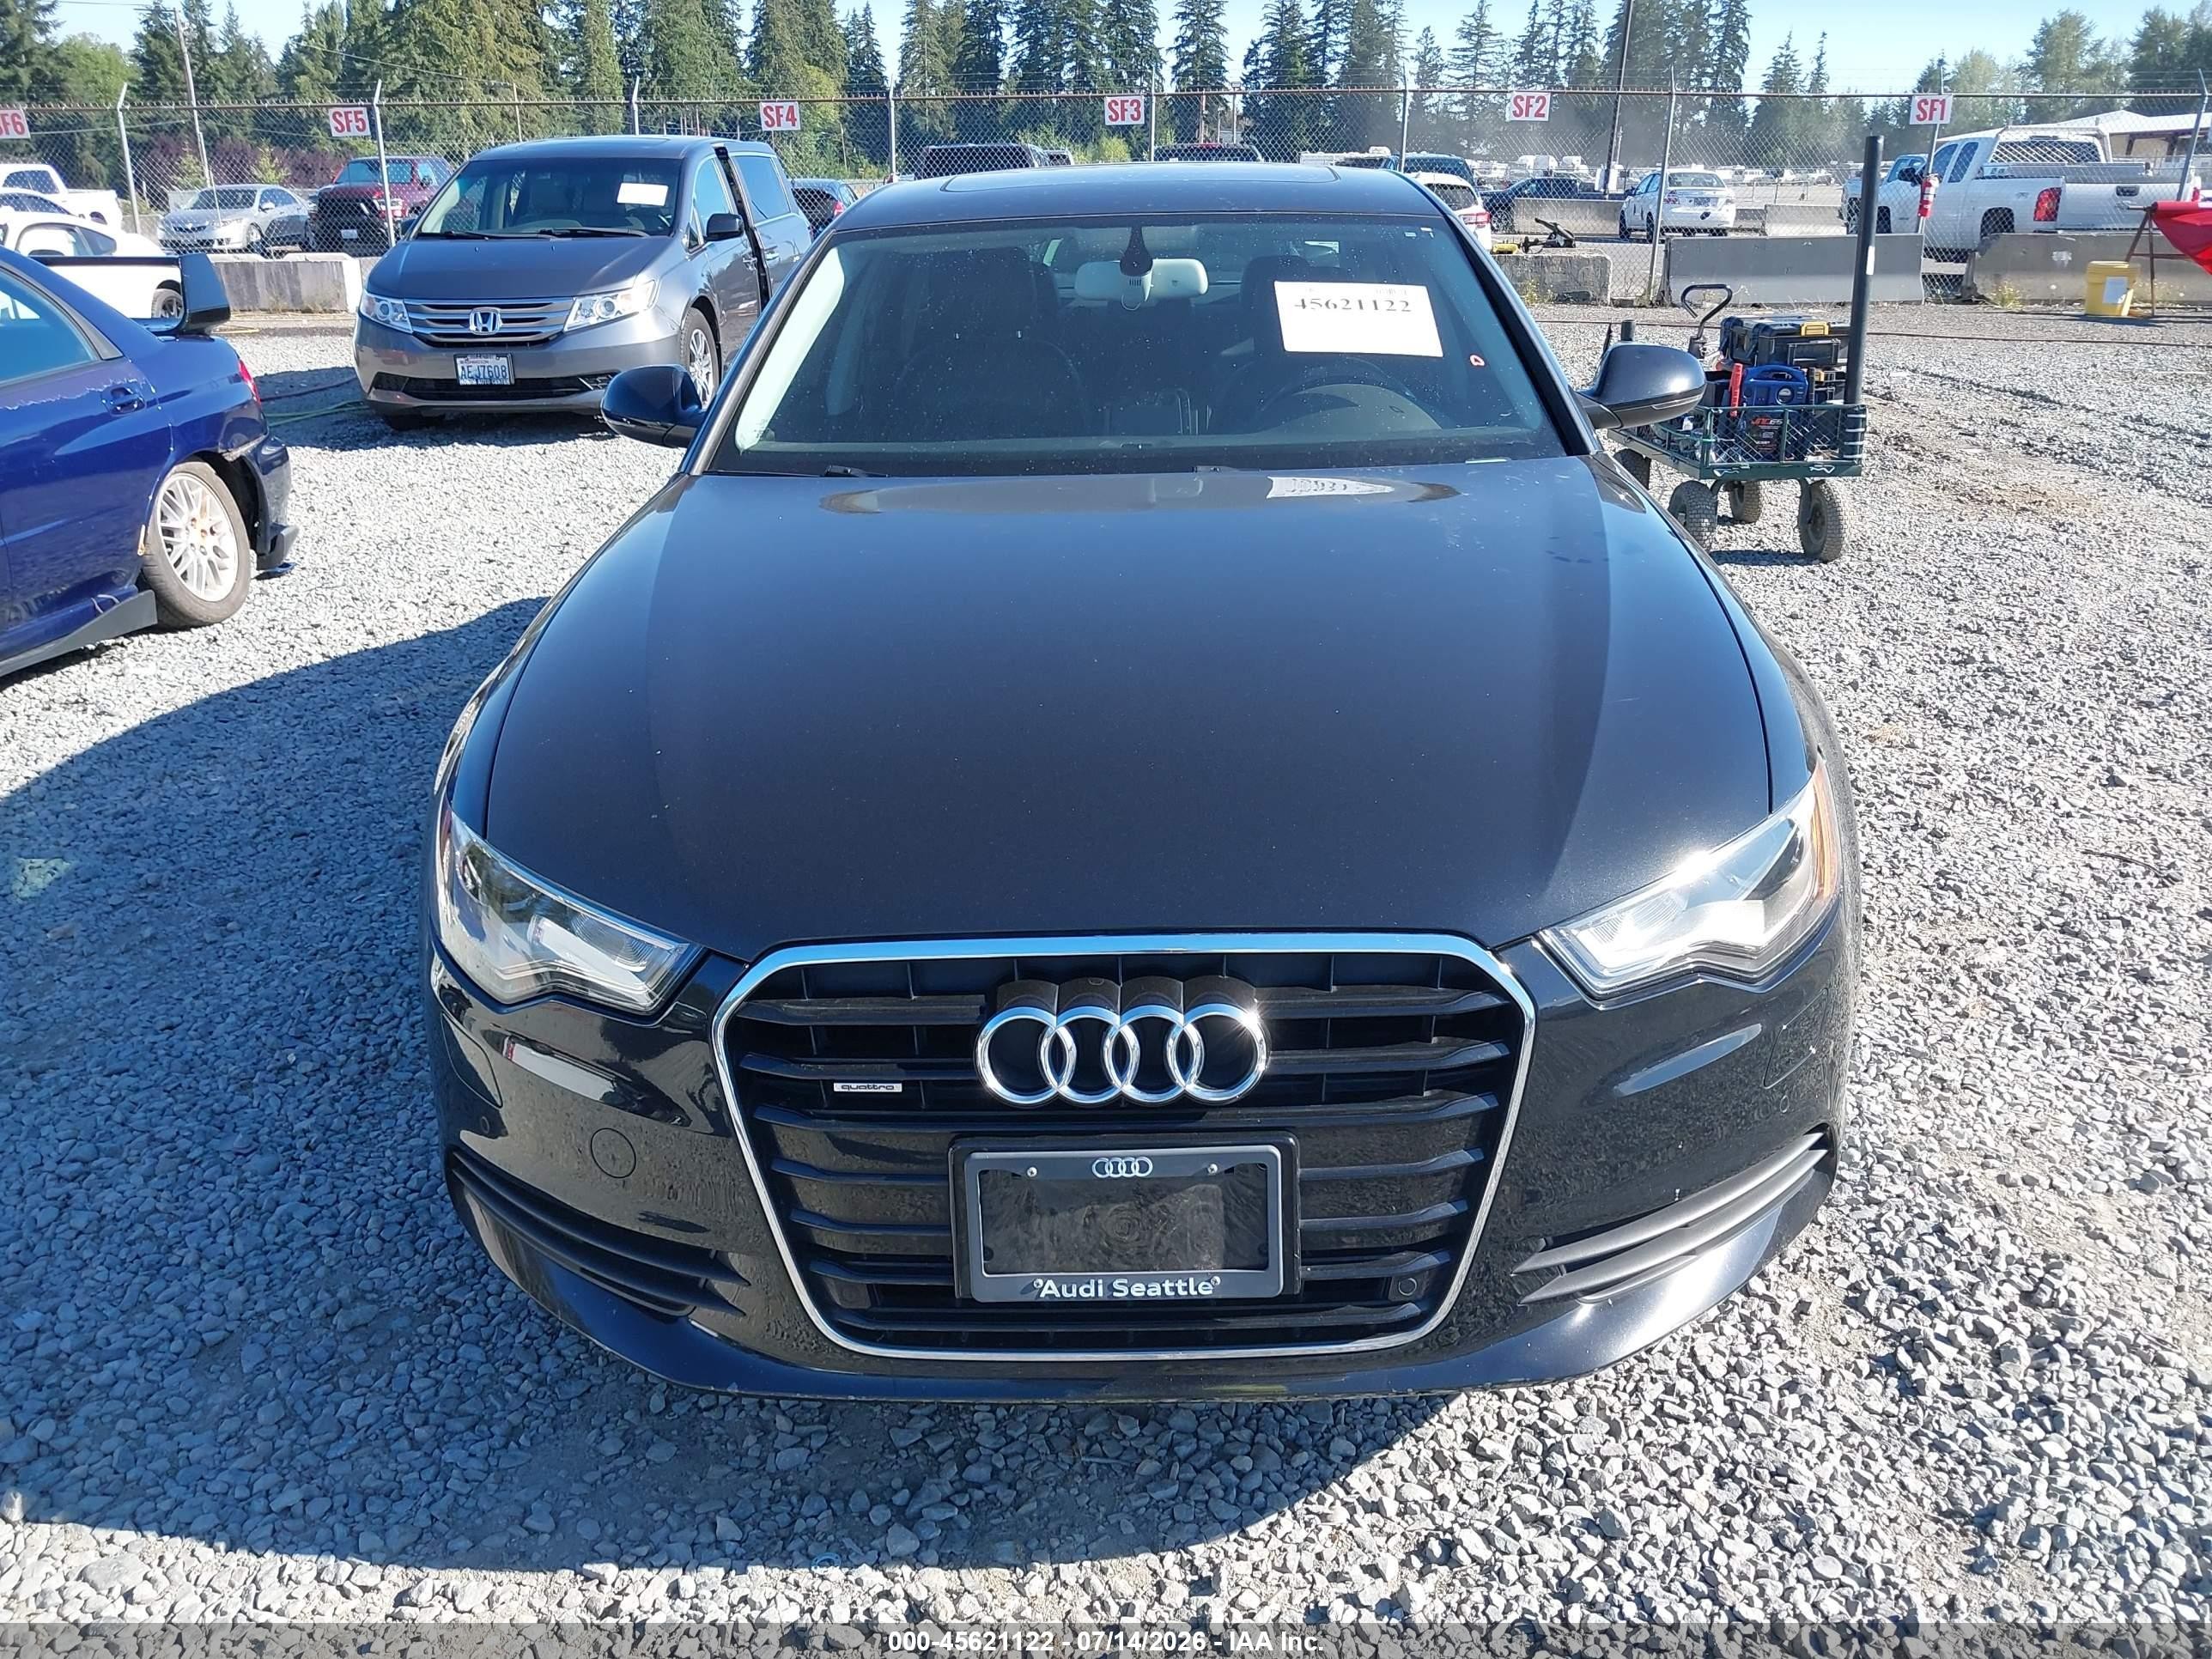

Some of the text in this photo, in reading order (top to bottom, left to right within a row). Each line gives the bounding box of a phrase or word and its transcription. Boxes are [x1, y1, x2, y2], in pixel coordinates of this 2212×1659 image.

[763, 105, 798, 128] SF4
[1107, 99, 1141, 122] SF3
[1511, 94, 1547, 118] SF2
[1916, 98, 1946, 122] SF1
[331, 110, 367, 133] SF5
[1294, 298, 1413, 313] 45621122
[1039, 1277, 1213, 1297] Audi Seattle
